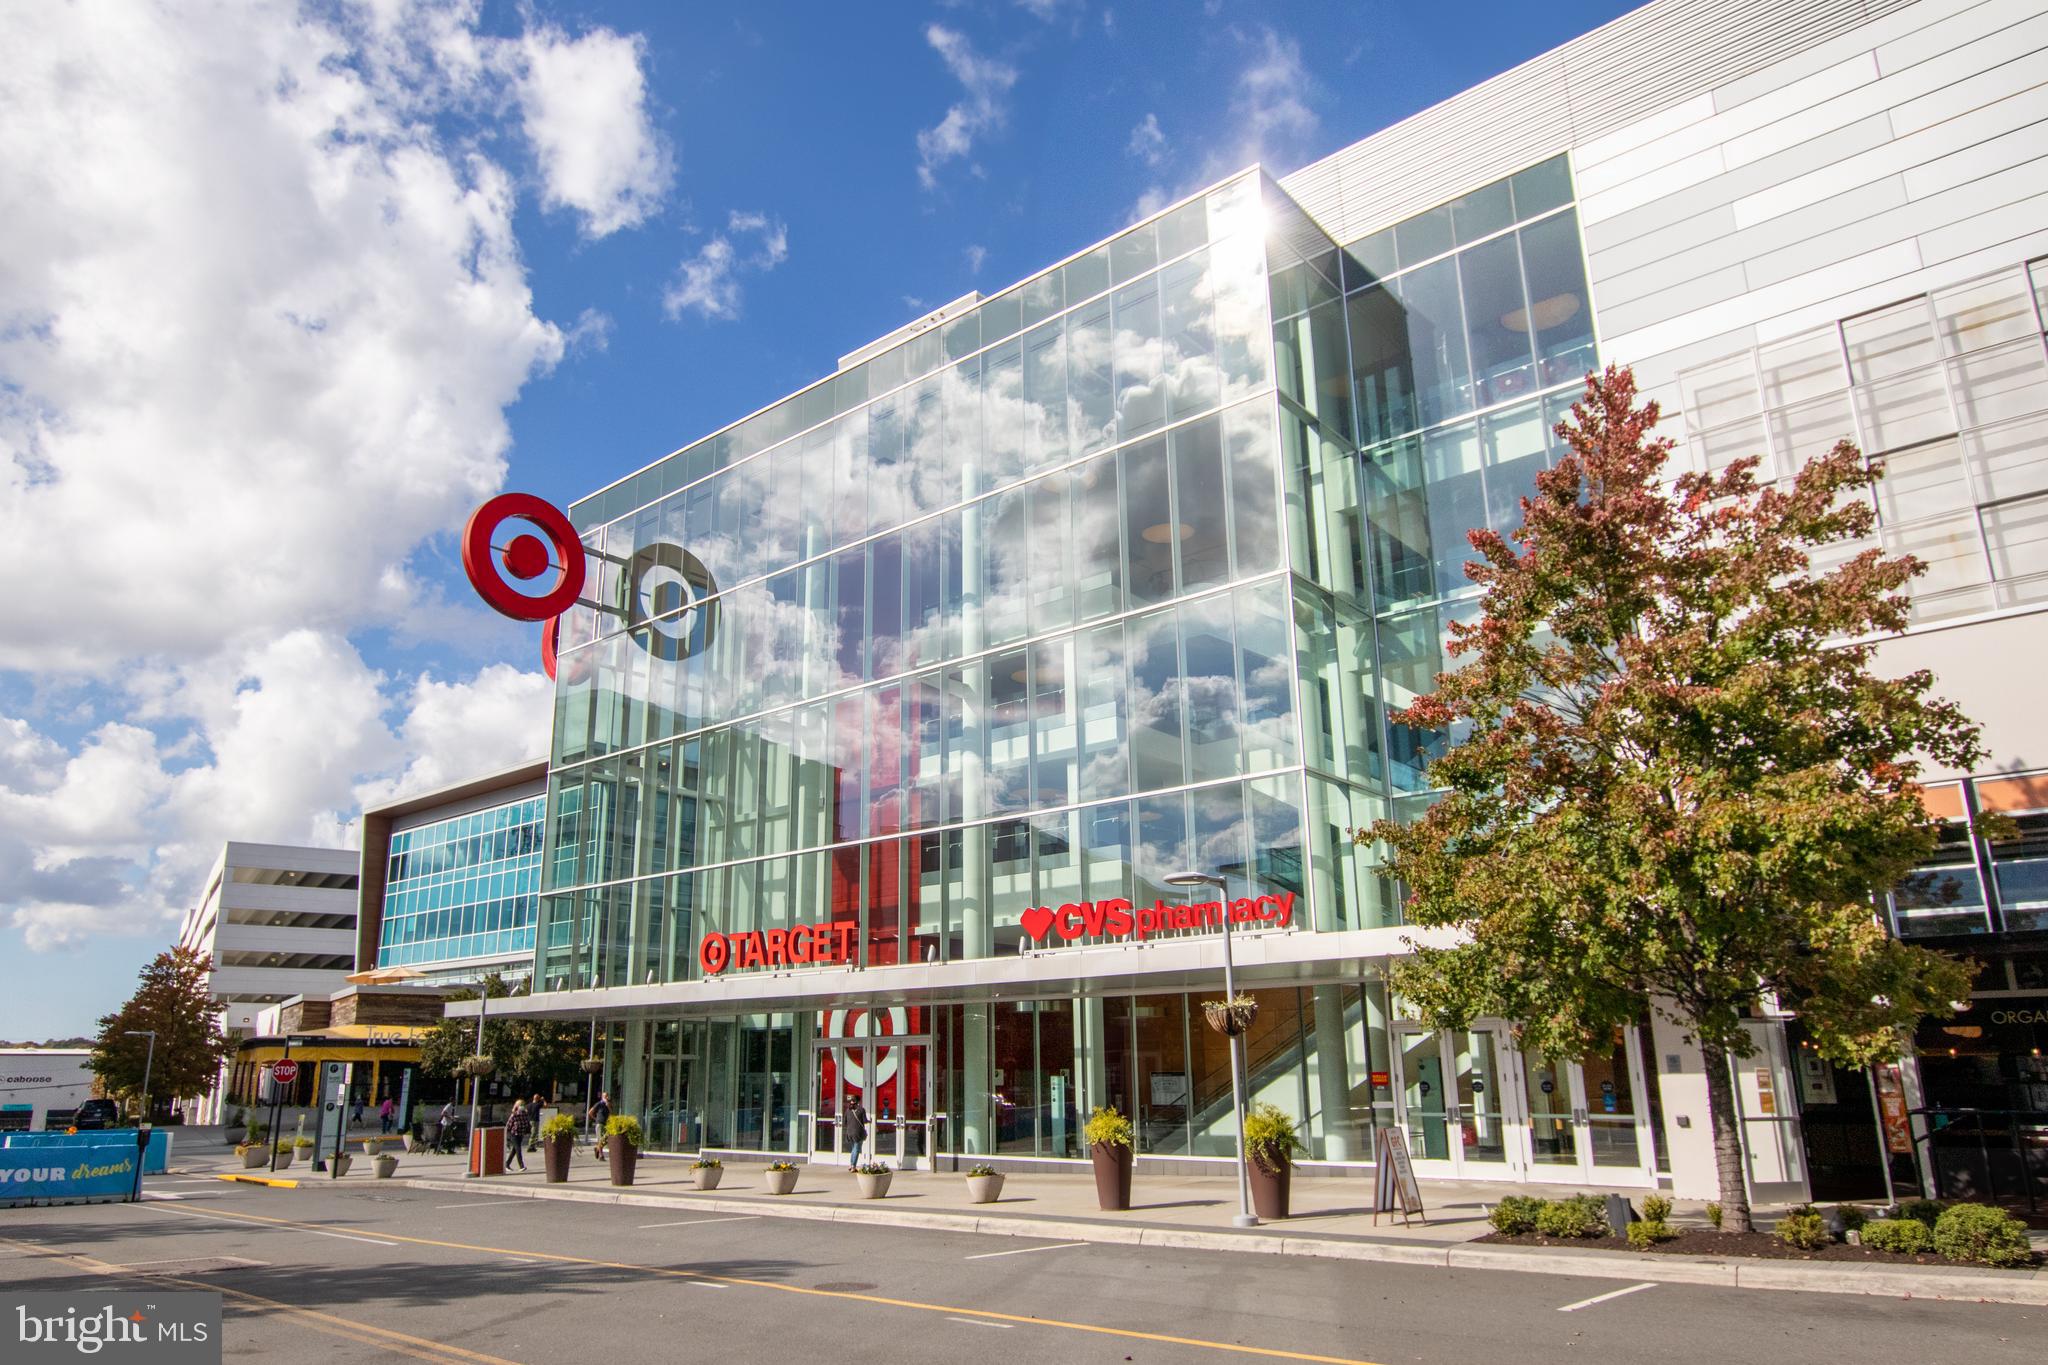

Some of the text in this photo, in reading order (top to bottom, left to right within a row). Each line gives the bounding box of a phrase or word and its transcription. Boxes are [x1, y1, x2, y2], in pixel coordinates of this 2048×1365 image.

[1055, 891, 1296, 940] CVS pharmacy
[729, 920, 858, 969] TARGET
[1991, 1010, 2048, 1024] ORGA
[366, 1025, 402, 1046] True
[274, 1066, 296, 1076] STOP
[0, 1159, 133, 1182] YOUR dreams
